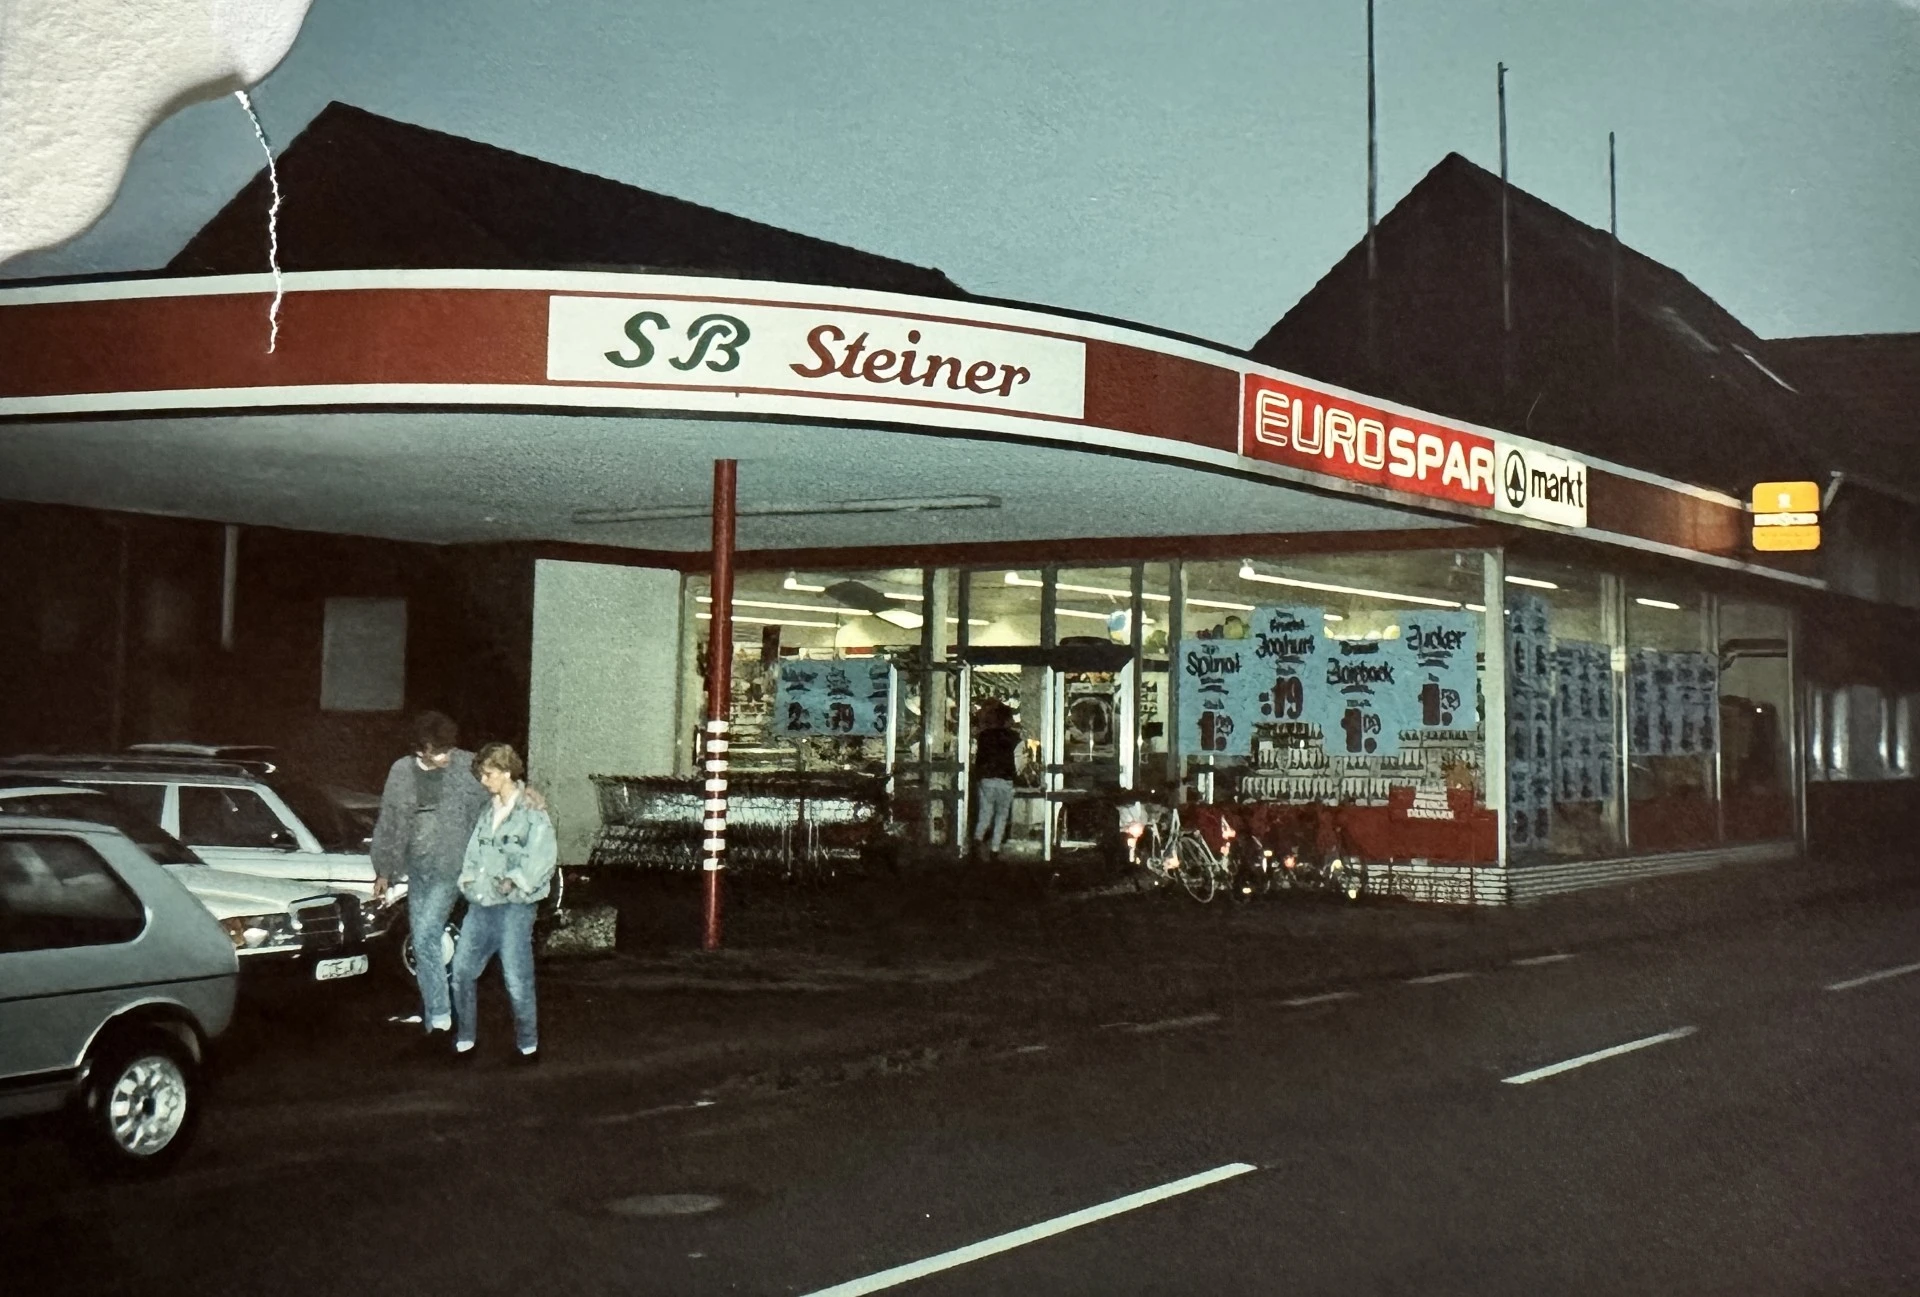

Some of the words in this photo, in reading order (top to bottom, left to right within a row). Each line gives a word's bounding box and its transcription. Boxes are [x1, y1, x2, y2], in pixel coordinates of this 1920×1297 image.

[790, 324, 1031, 397] Steiner
[1255, 388, 1495, 495] EUROSPAR
[1531, 465, 1584, 508] markt
